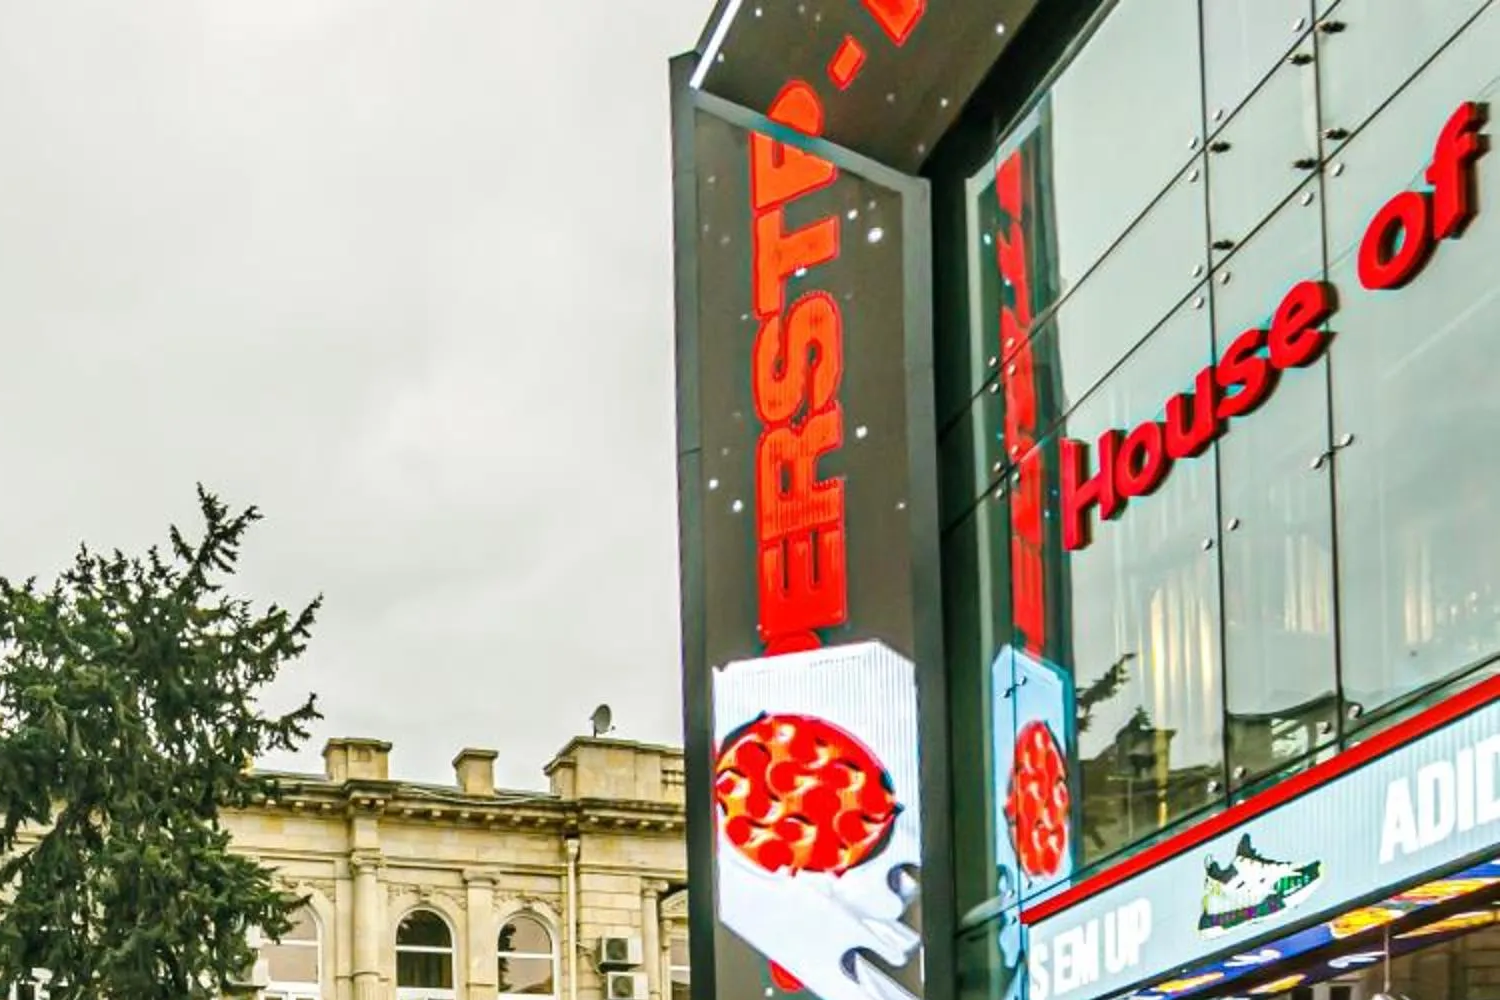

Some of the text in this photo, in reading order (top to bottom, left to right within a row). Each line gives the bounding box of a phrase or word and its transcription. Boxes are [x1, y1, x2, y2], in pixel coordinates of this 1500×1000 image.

[1060, 280, 1338, 551] House
[1357, 101, 1491, 290] of
[1104, 898, 1151, 973] UP
